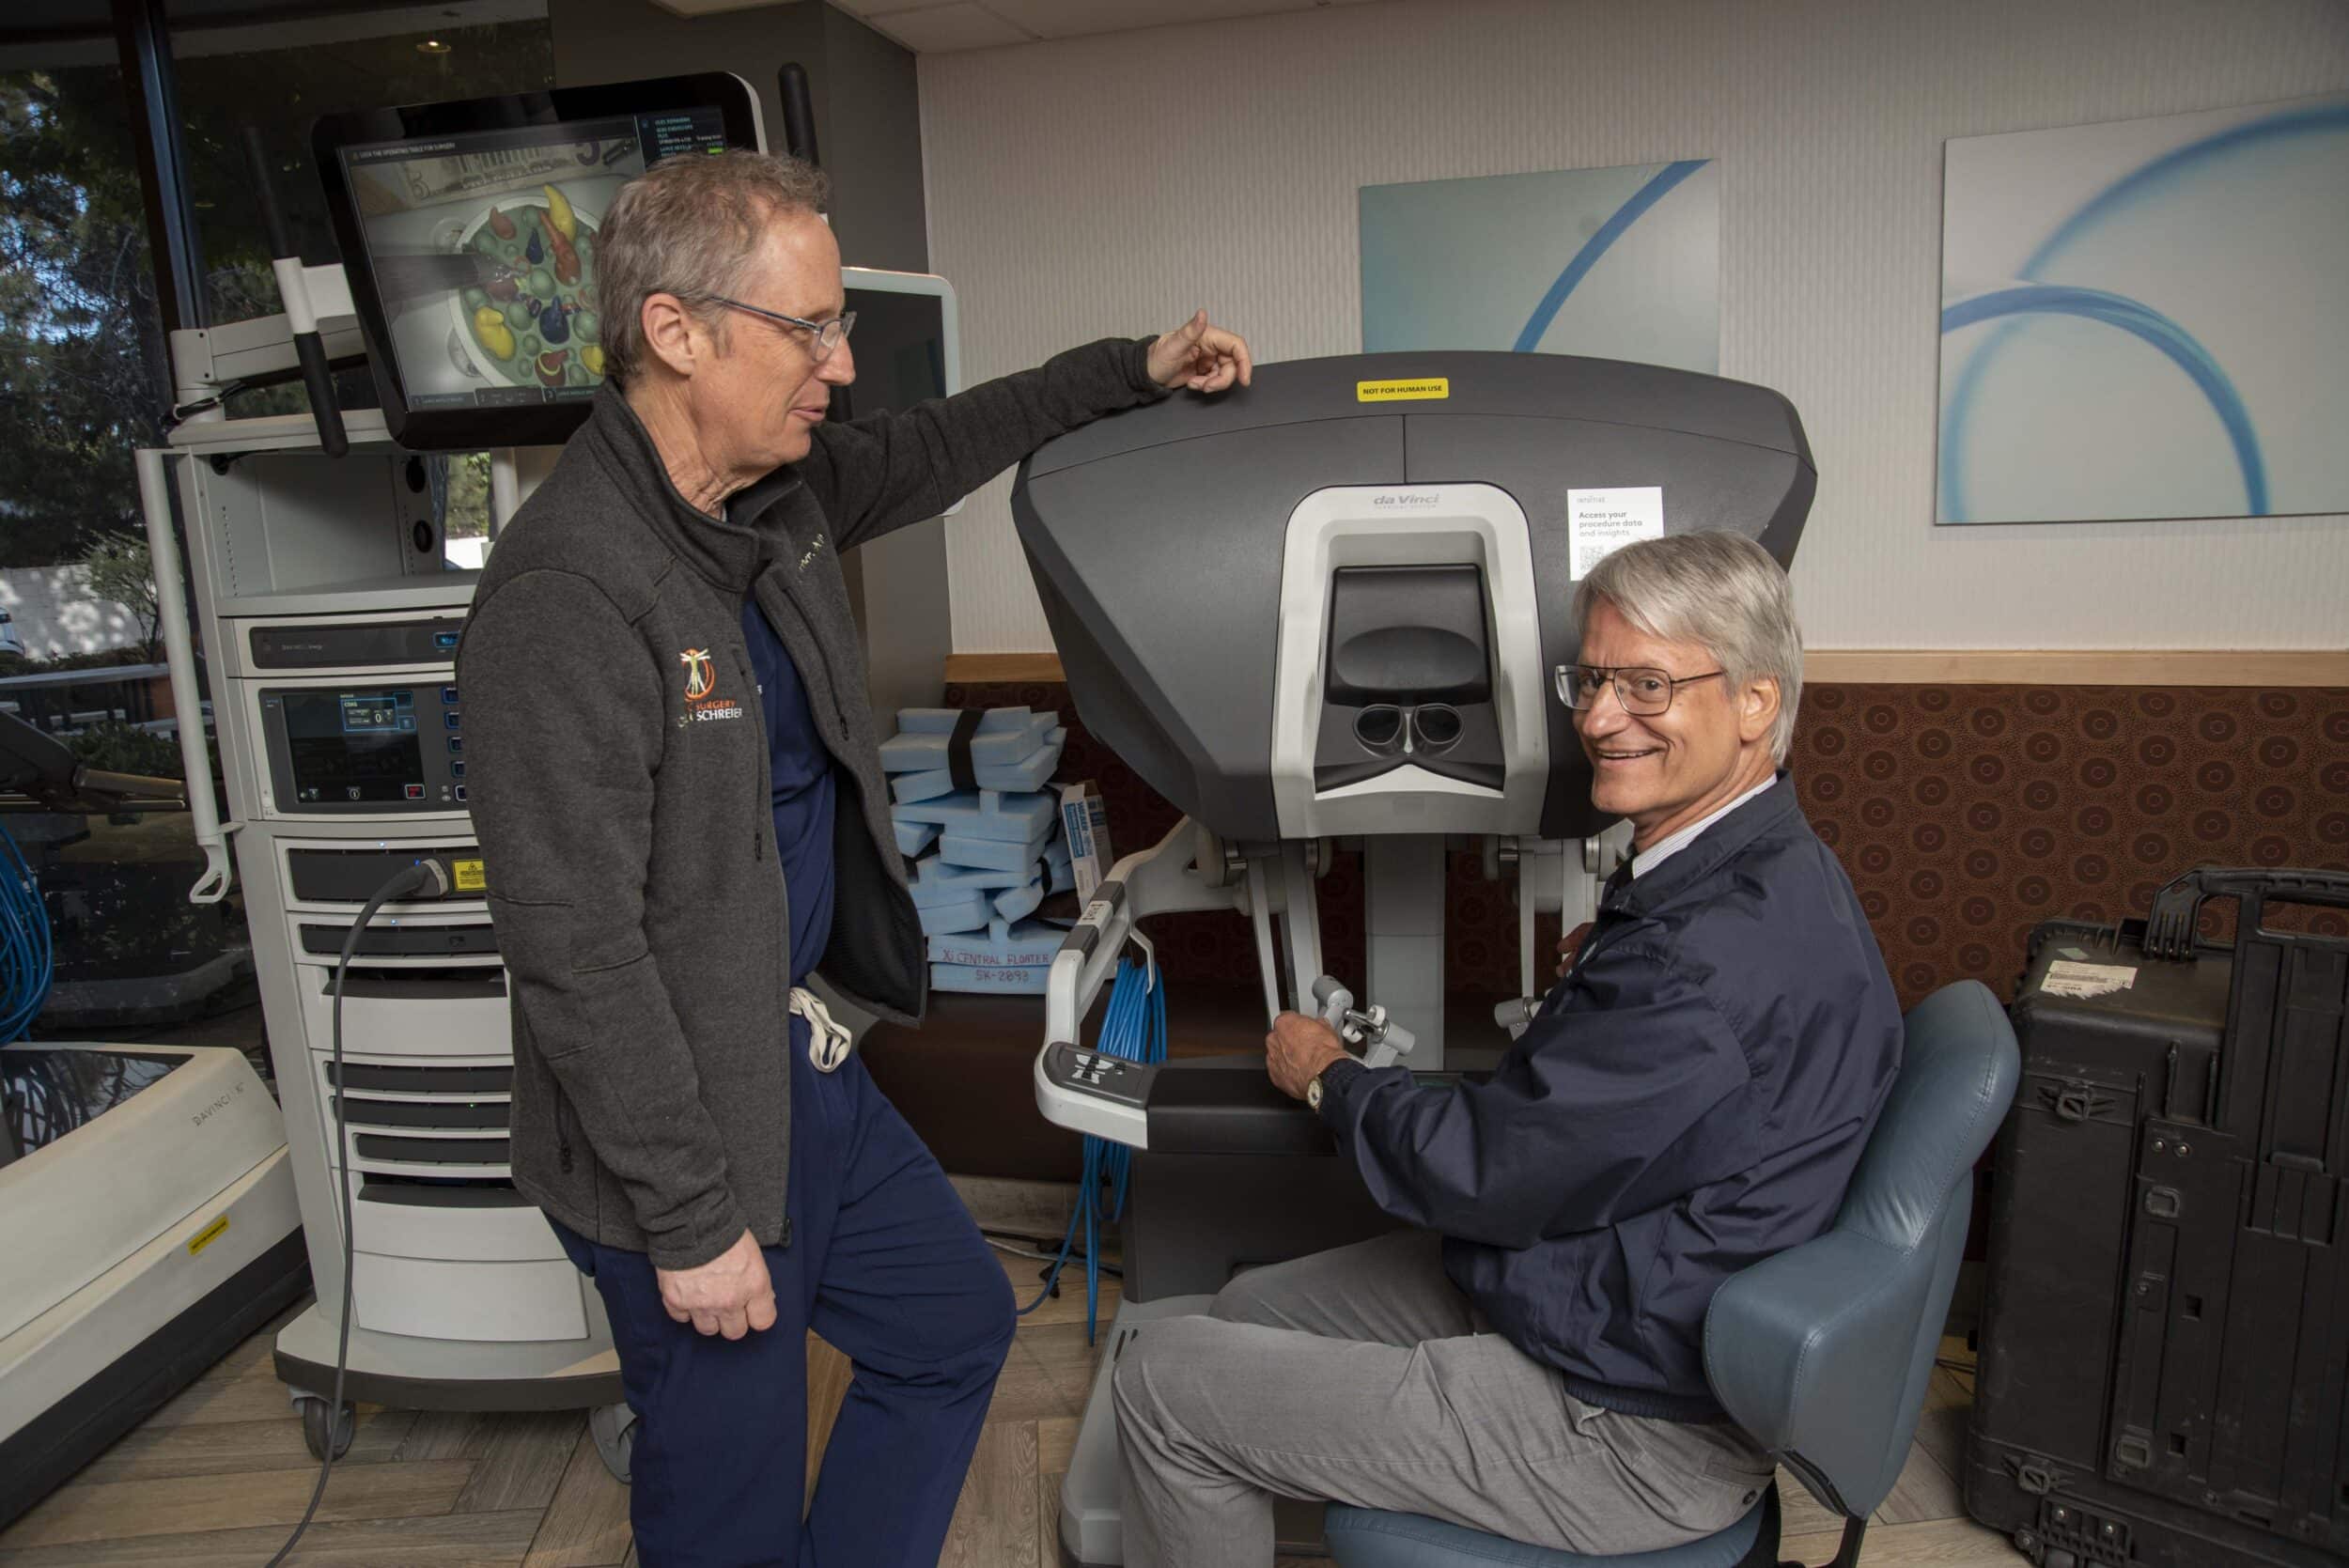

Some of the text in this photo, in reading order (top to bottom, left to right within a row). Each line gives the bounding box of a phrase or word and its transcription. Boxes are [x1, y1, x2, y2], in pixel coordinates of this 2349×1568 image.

[1374, 493, 1439, 505] da Vinci
[1579, 519, 1643, 529] procedure data
[1596, 529, 1630, 538] insights
[957, 953, 1002, 965] CENTRAL
[1007, 954, 1050, 965] FLOATER
